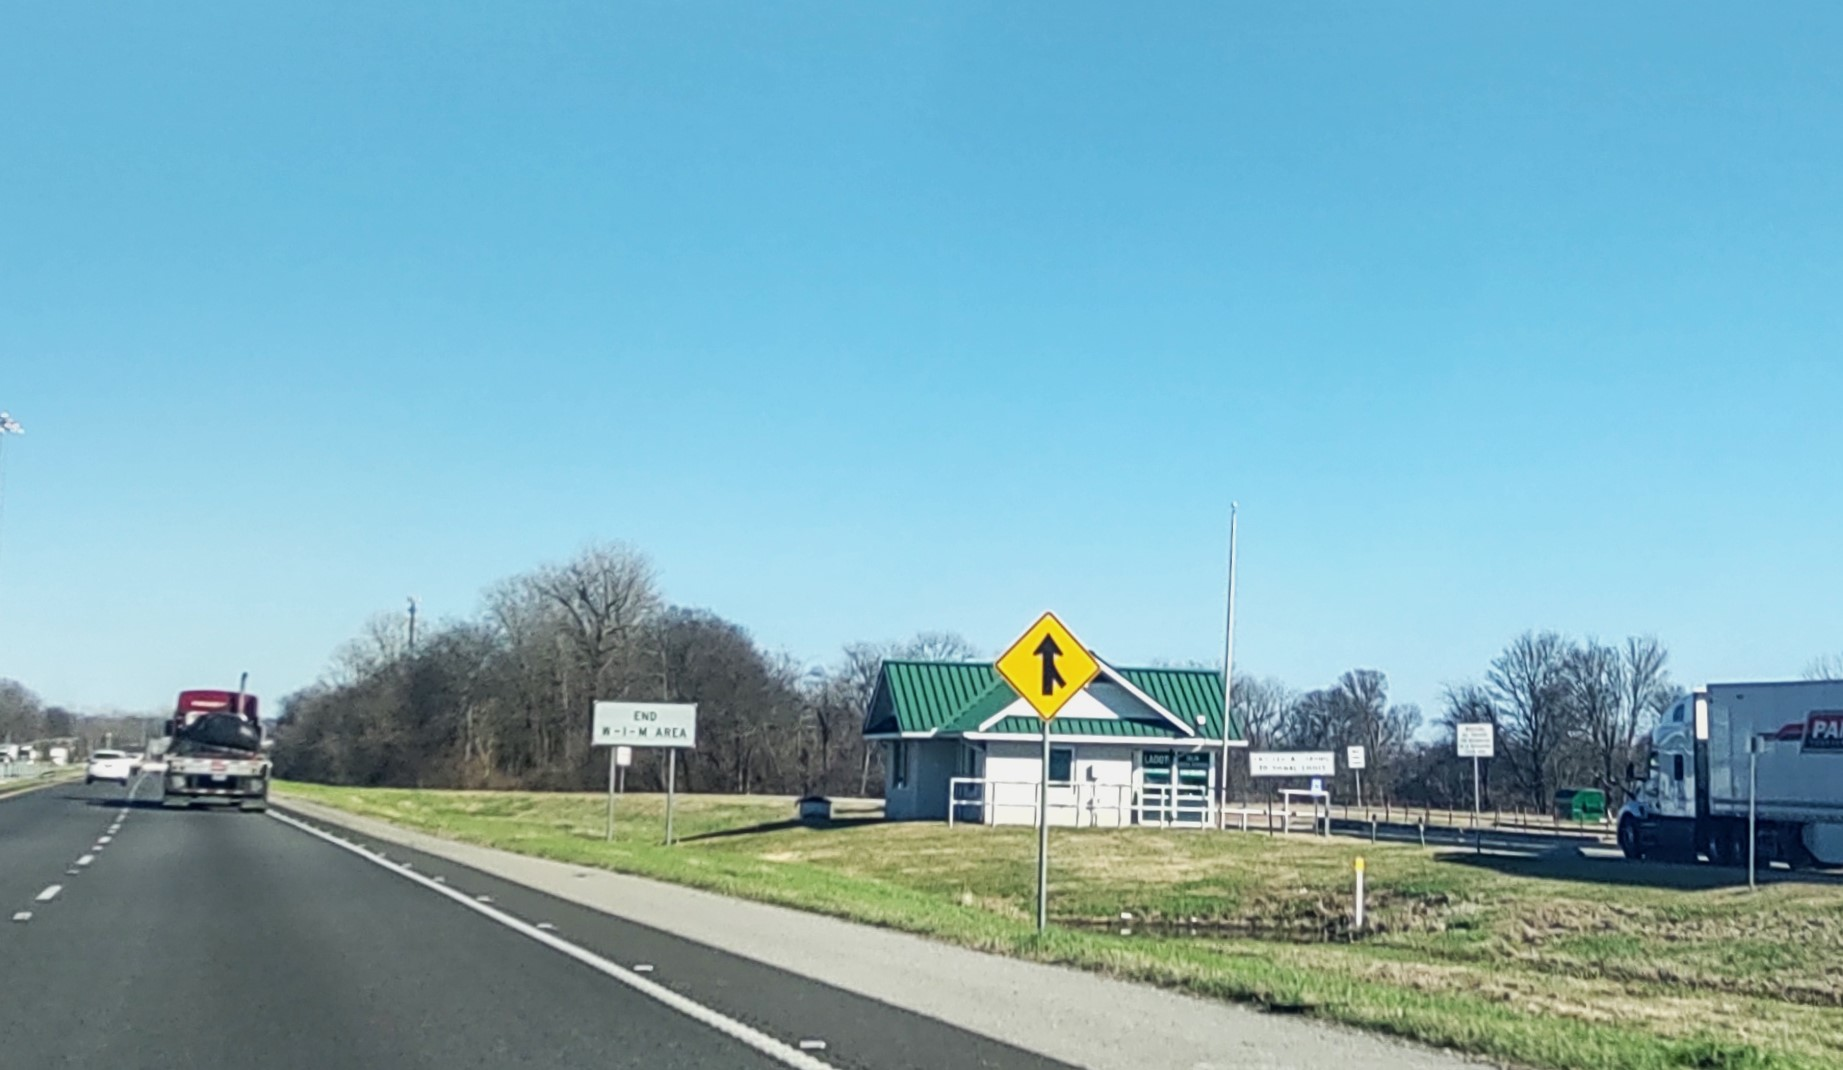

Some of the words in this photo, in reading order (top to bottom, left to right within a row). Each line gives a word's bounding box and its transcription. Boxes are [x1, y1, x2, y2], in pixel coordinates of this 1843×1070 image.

[634, 711, 657, 721] END
[656, 727, 686, 738] AREA
[1812, 720, 1843, 739] PA
